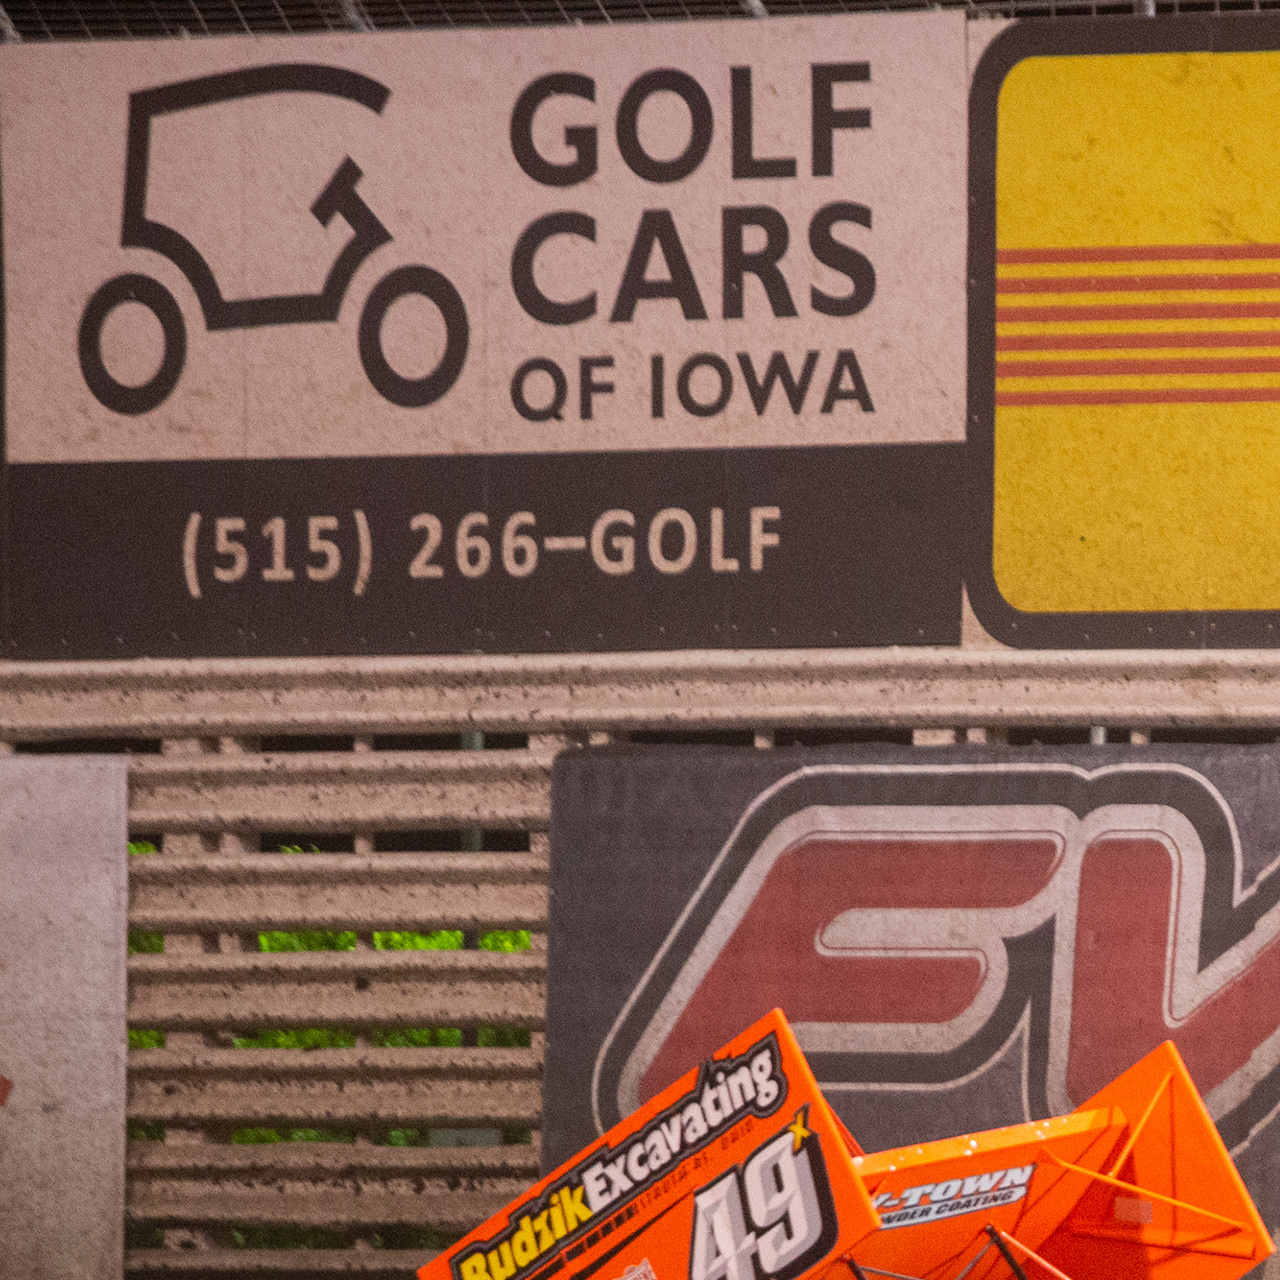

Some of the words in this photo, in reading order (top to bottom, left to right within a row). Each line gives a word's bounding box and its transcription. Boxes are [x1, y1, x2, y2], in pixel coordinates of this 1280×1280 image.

[509, 61, 872, 188] GOLF
[509, 201, 877, 326] CARS
[650, 348, 876, 420] IOWA
[182, 509, 372, 599] (515)
[408, 505, 783, 581] 266-GOLF
[882, 1206, 932, 1225] WDER
[935, 1191, 1015, 1215] COATING
